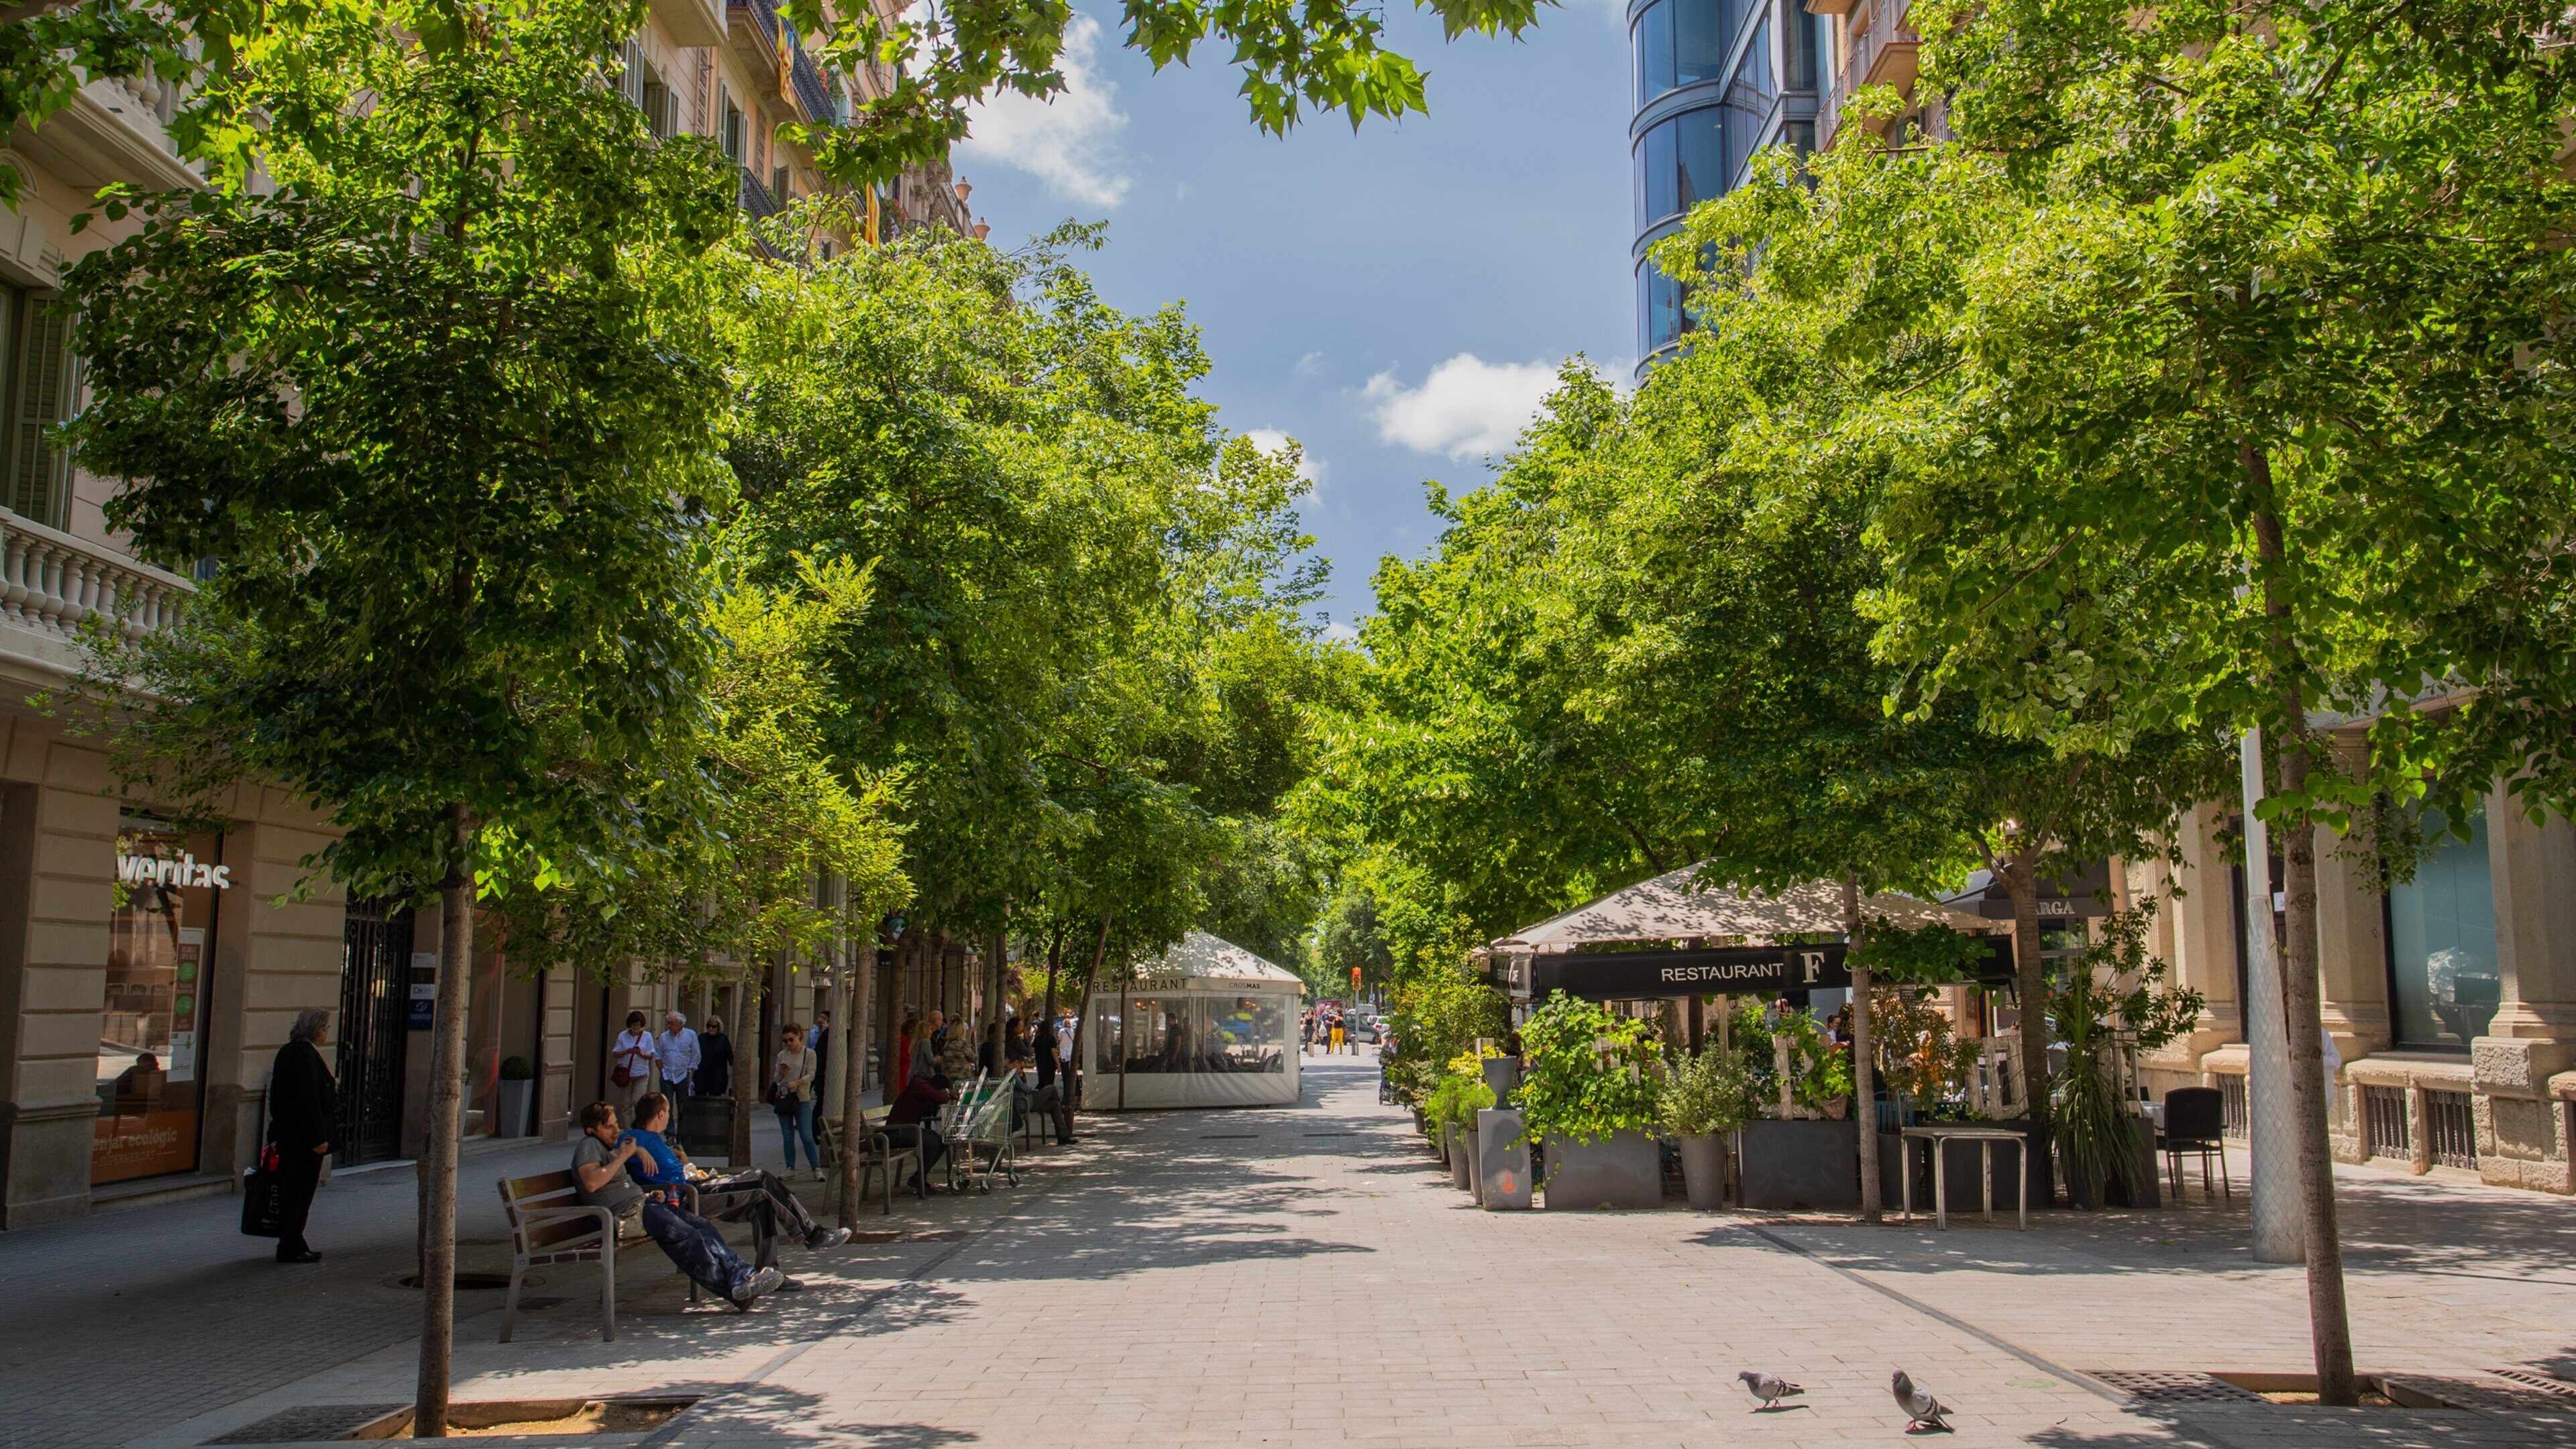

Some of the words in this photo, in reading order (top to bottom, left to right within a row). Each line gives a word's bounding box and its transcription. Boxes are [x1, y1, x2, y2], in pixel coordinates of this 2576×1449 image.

[117, 848, 230, 889] veritas
[1661, 963, 1784, 981] RESTAURANT
[1801, 952, 1825, 983] F
[1092, 978, 1187, 991] RESAURANT
[93, 1133, 125, 1155] enjar
[99, 1150, 155, 1167] SUPERMERCAT
